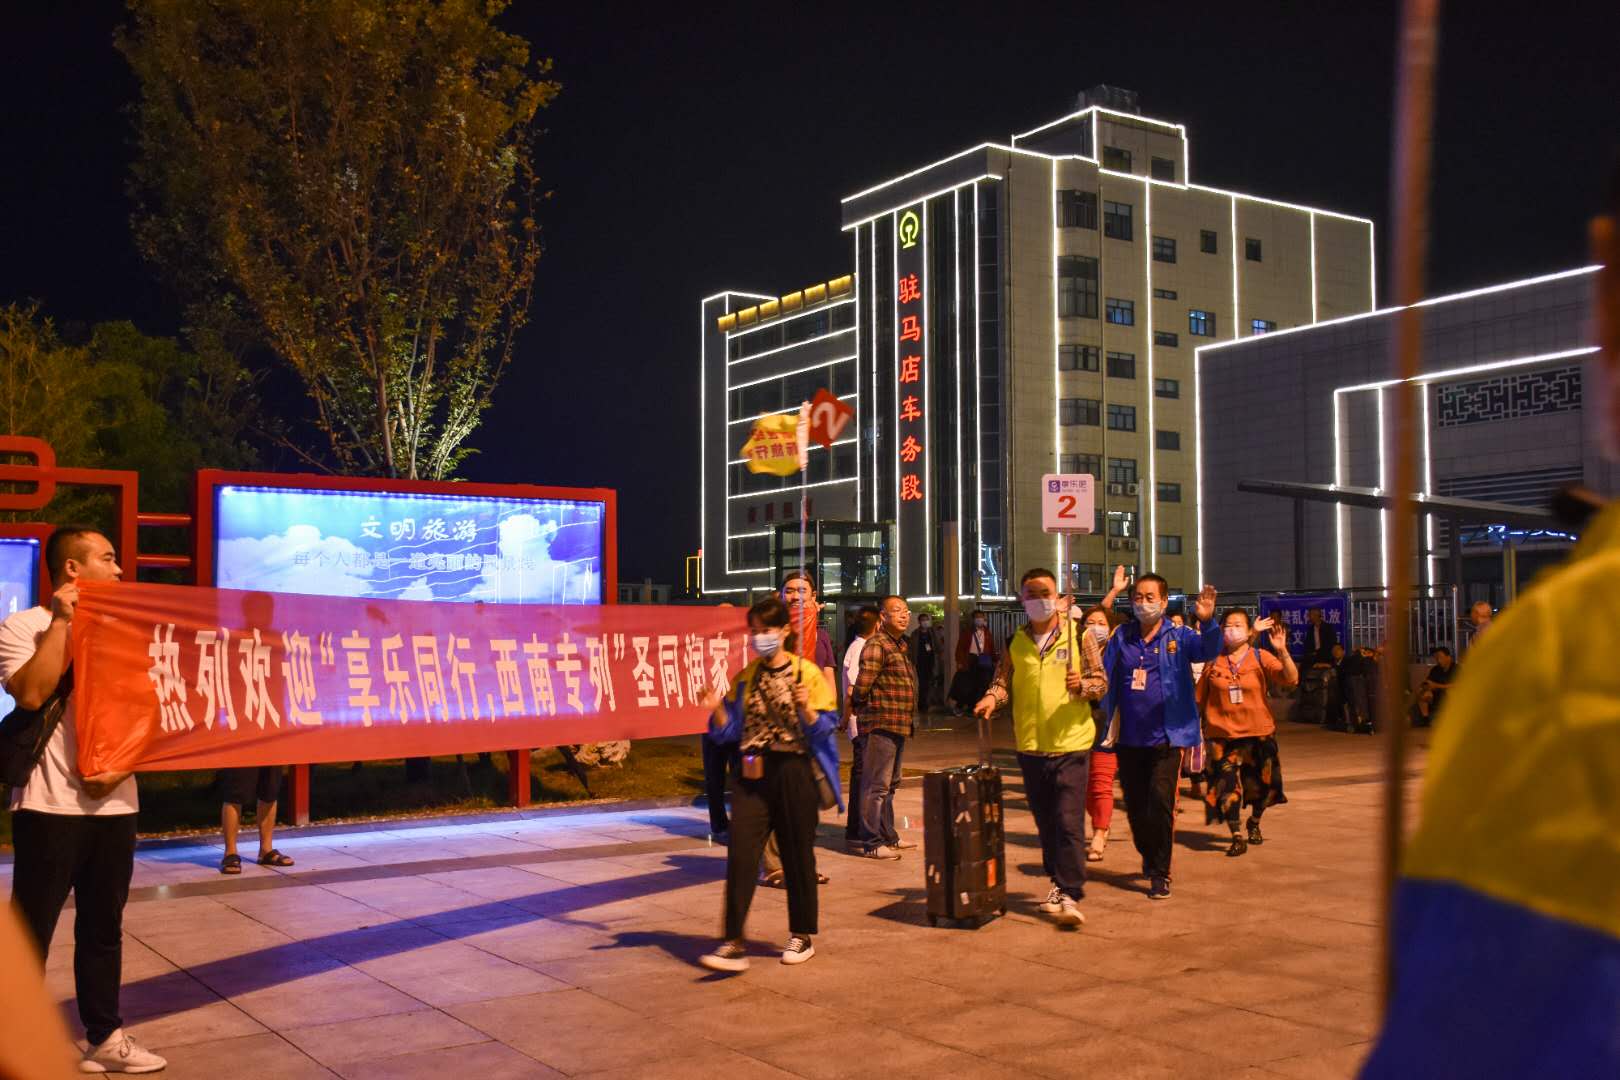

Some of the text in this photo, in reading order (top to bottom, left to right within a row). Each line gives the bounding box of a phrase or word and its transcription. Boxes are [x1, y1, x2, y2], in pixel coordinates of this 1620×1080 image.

[899, 273, 922, 500] 驻马店车务段
[813, 401, 850, 440] 2
[1058, 495, 1077, 519] 2
[360, 516, 480, 544] 文明旅游
